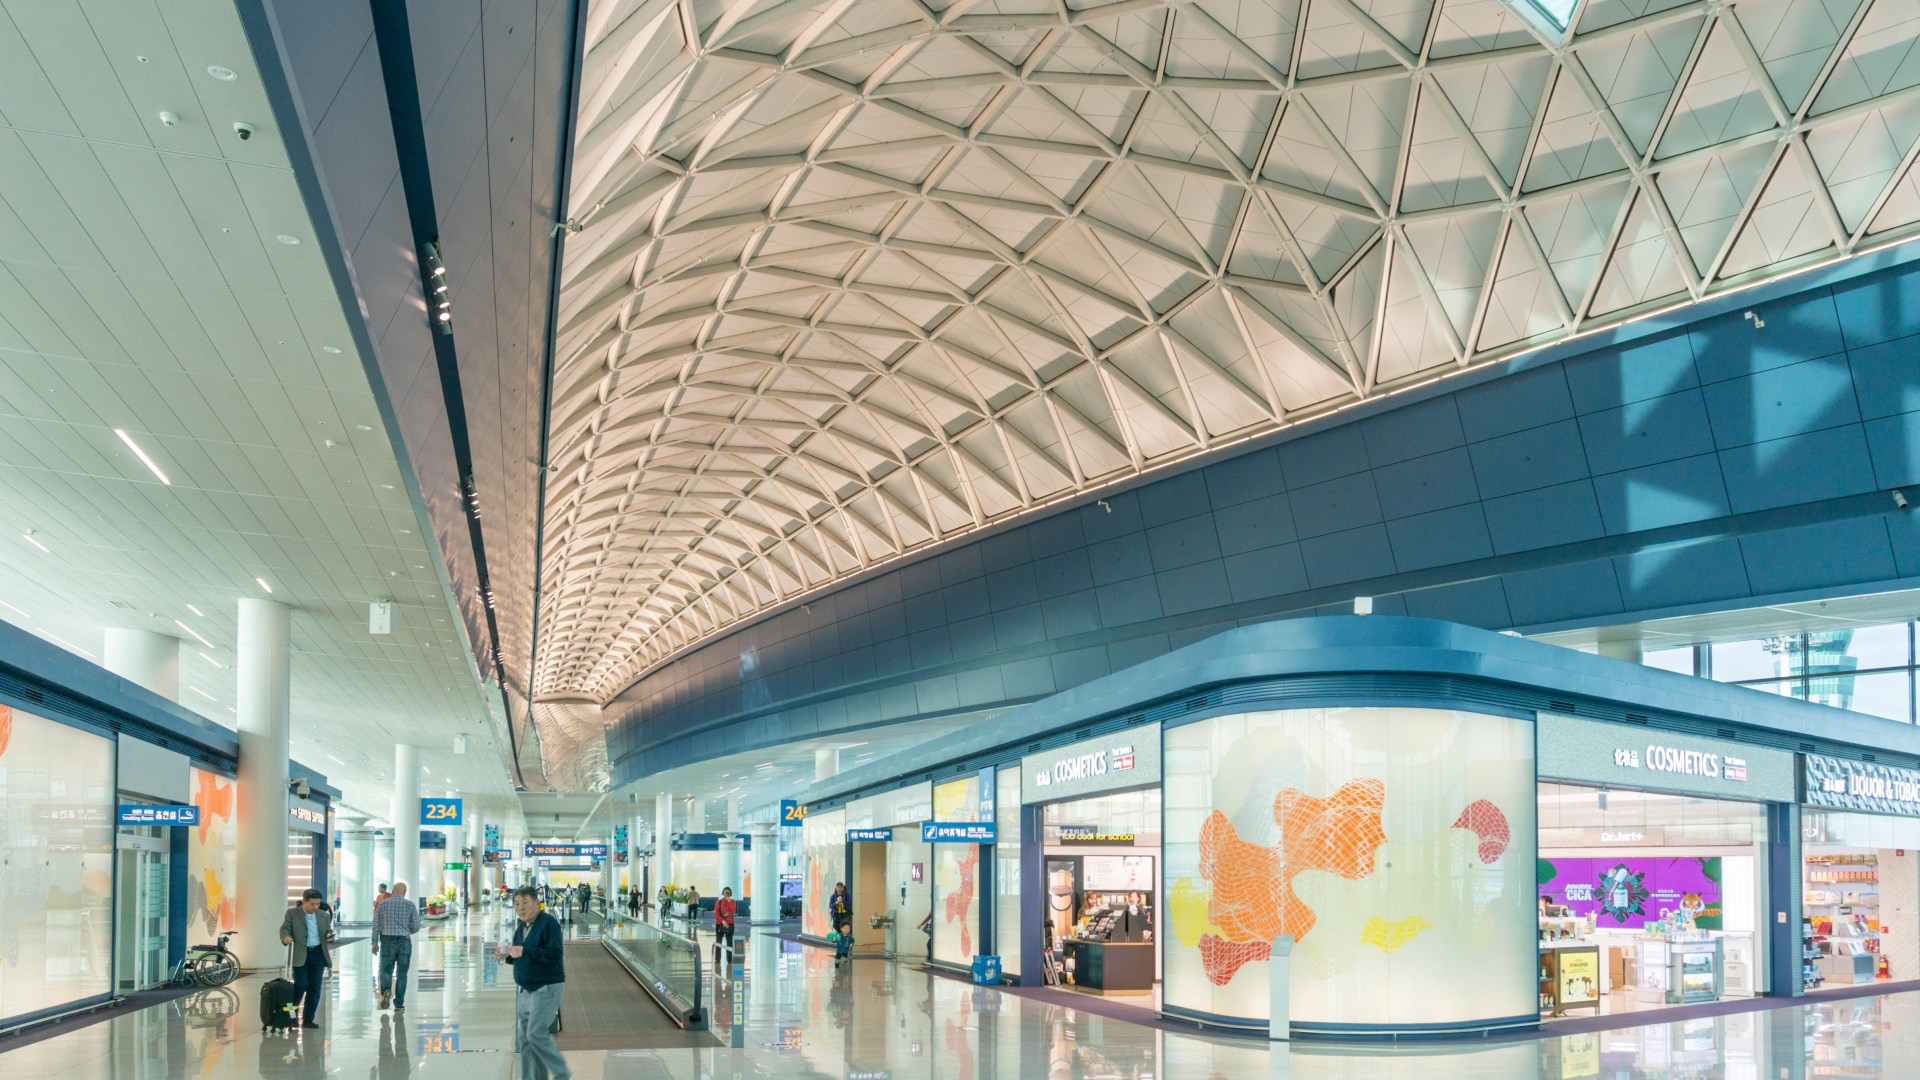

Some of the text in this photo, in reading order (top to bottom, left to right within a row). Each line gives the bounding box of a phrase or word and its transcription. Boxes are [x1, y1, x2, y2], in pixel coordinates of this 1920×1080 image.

[1054, 751, 1107, 783] COSMETICS
[1646, 745, 1718, 777] COSMETICS
[1851, 775, 1885, 799] LIQUOR
[1886, 780, 1894, 799] &
[426, 804, 457, 819] 234
[1601, 832, 1644, 841] Dr.Jart+
